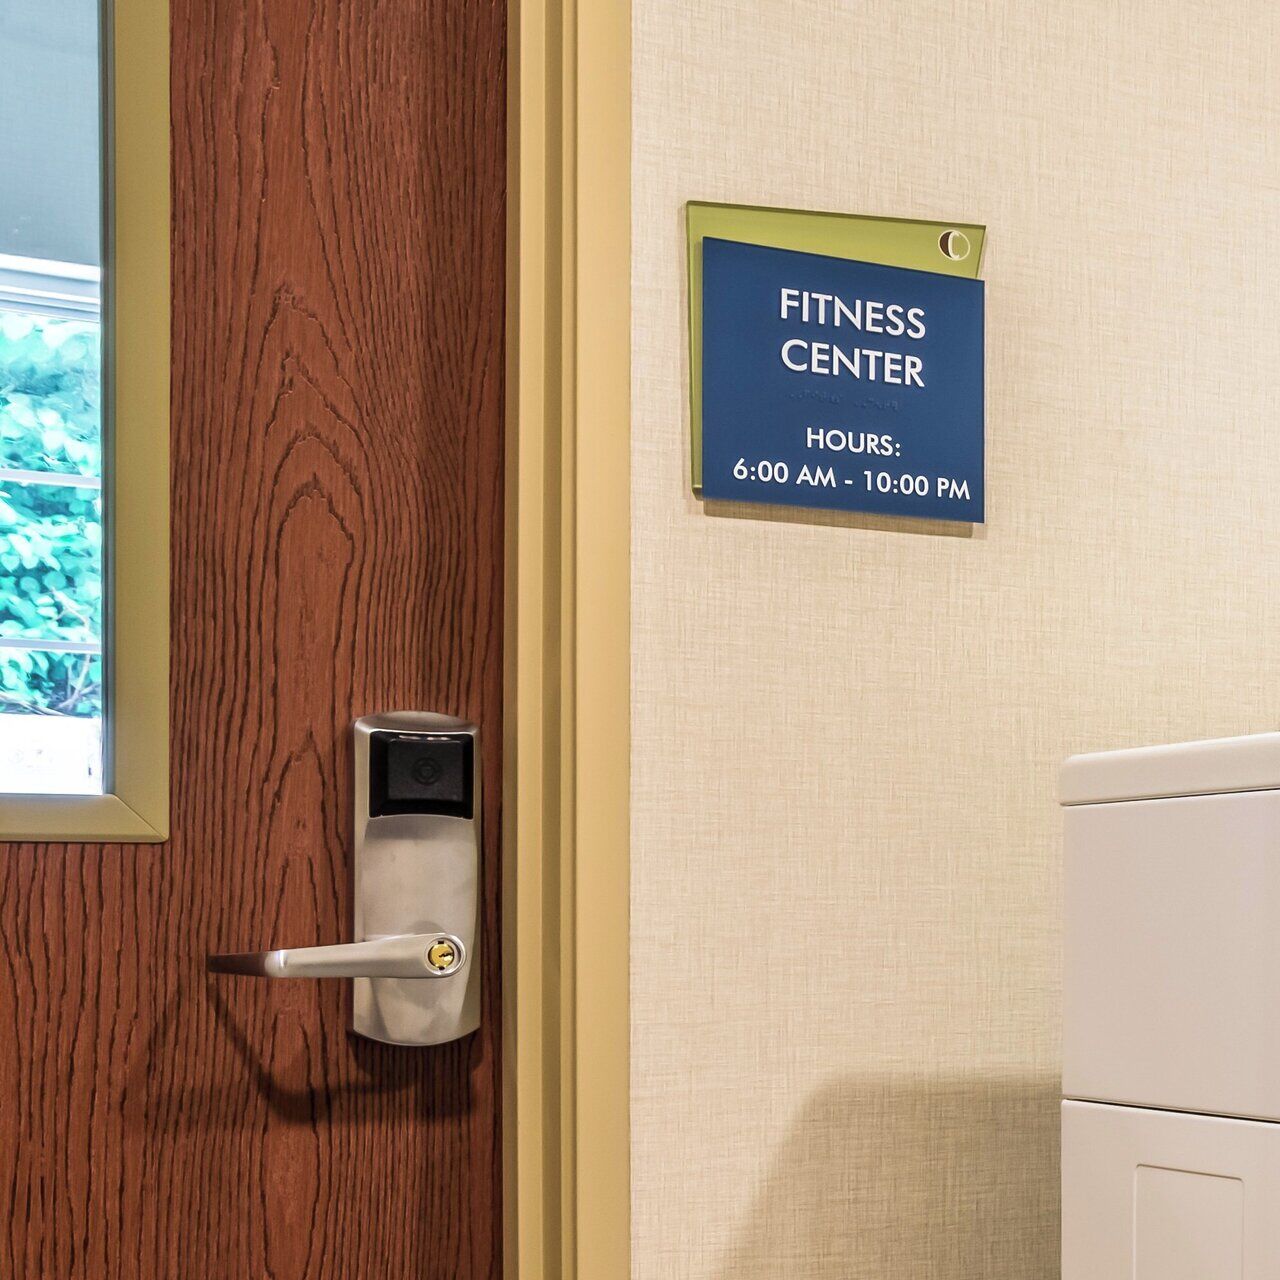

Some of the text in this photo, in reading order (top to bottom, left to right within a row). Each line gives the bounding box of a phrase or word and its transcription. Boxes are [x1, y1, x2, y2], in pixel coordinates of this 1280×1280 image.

[780, 287, 926, 339] FITNESS
[781, 339, 925, 387] CENTER
[807, 427, 901, 457] HOURS:
[733, 458, 789, 483] 6:00
[796, 464, 836, 487] AM
[863, 471, 928, 496] 10:00
[937, 478, 970, 500] PM
